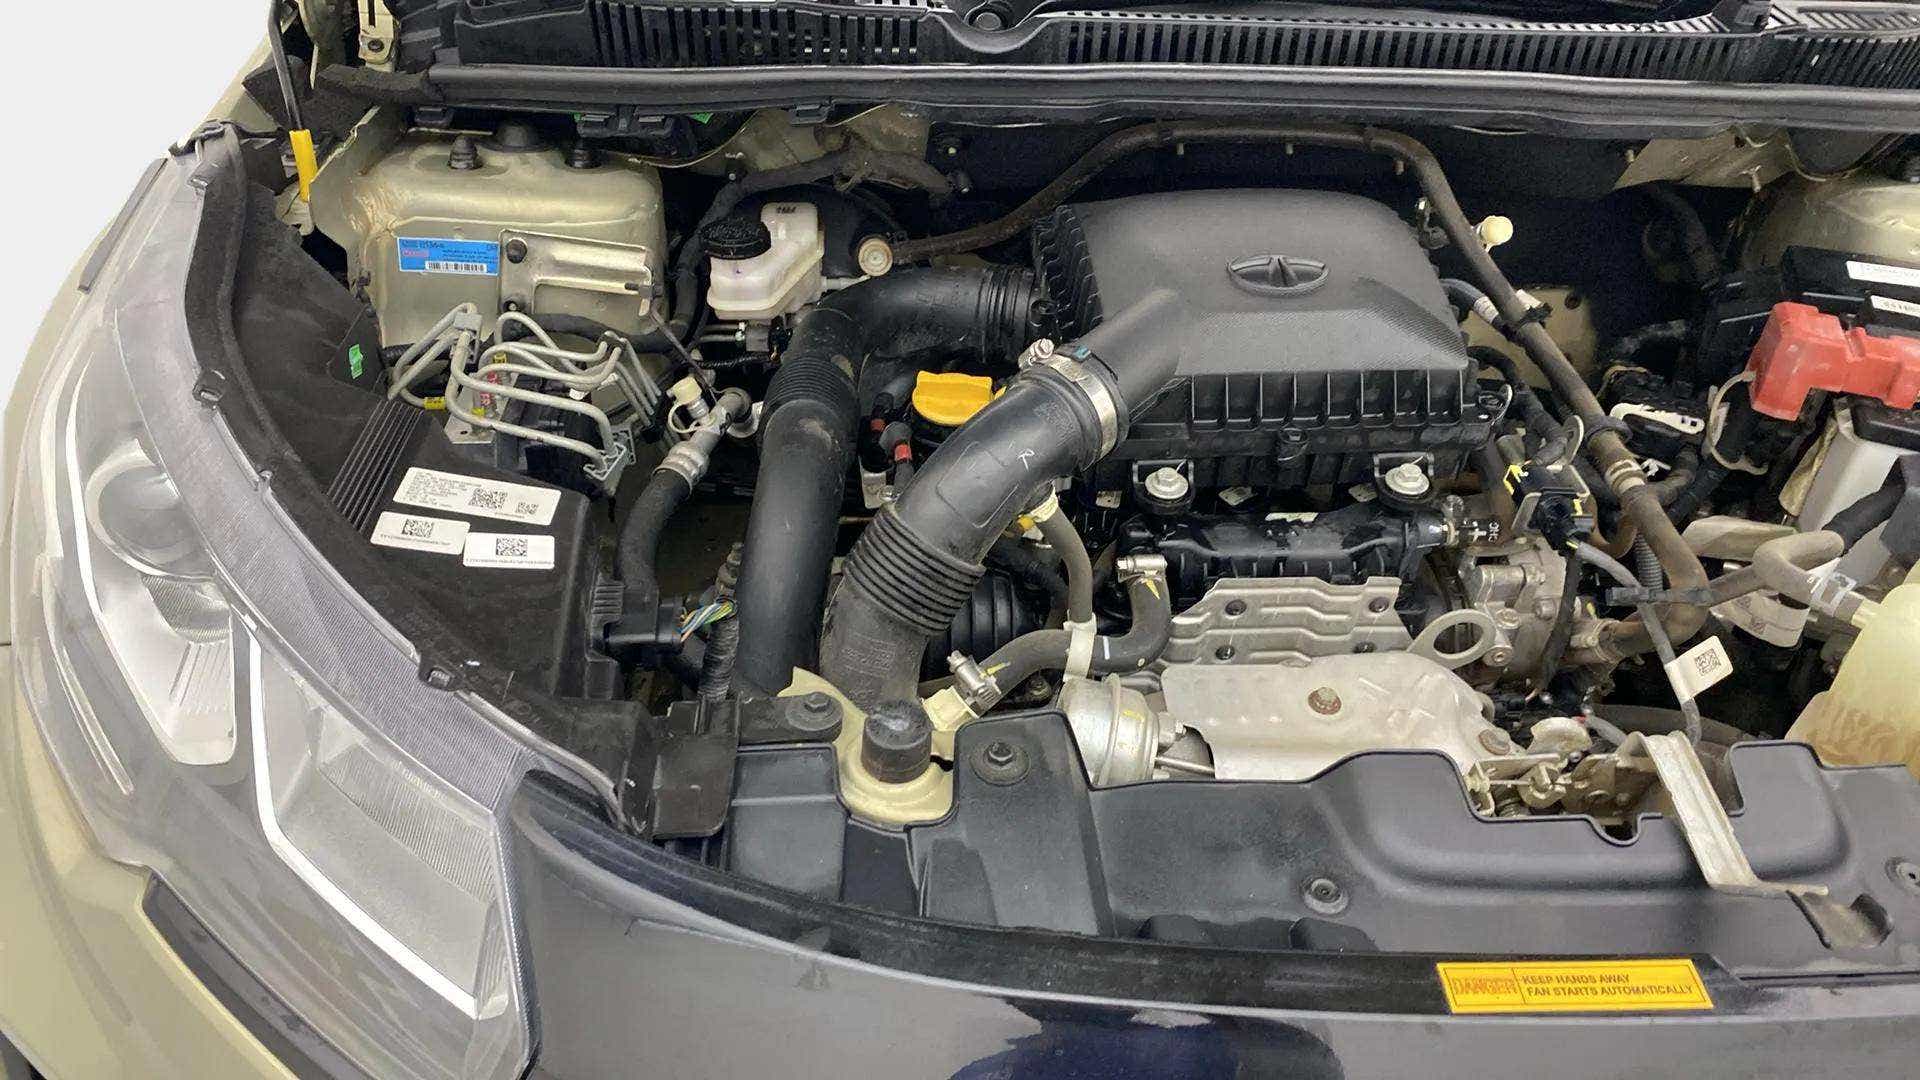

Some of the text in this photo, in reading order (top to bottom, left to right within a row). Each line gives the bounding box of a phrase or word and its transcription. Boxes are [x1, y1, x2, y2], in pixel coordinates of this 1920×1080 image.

[1522, 973, 1630, 985] KEEP HANDS AWAY
[1526, 984, 1694, 996] FAN STARTS AUTOMATICALLY
